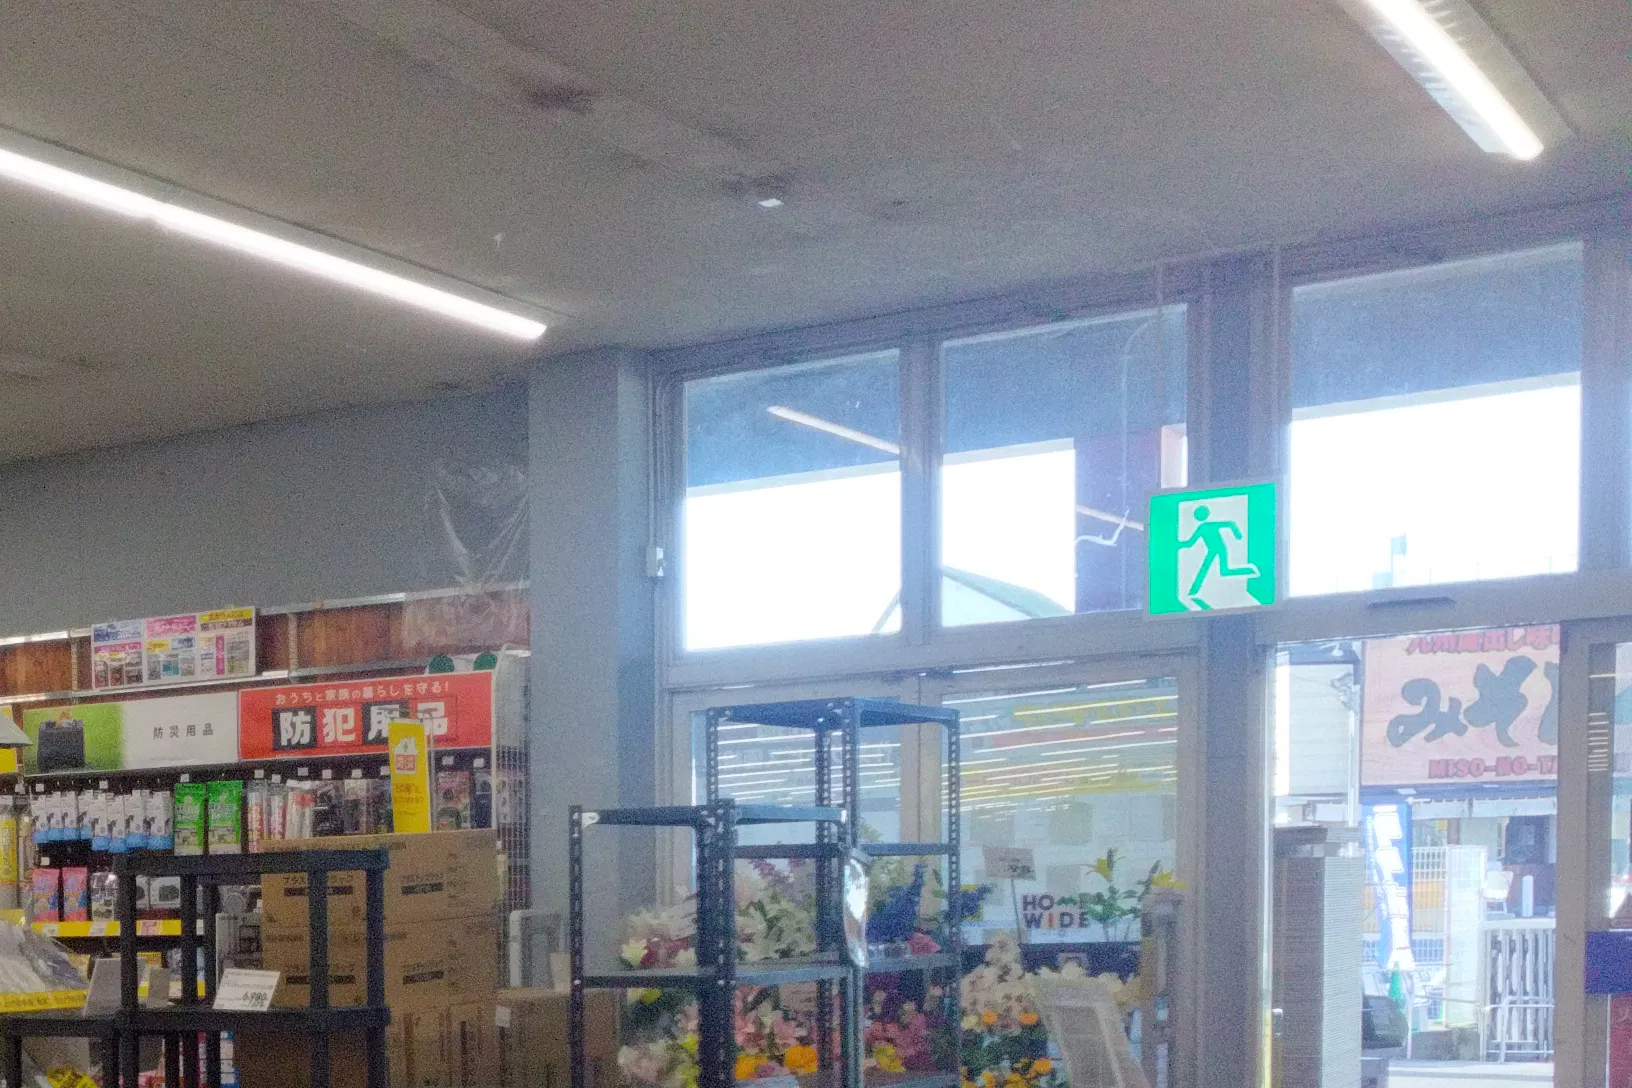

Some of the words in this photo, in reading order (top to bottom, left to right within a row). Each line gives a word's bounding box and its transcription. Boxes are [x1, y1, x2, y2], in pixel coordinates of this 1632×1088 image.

[152, 722, 215, 740] 防災用品
[279, 701, 449, 745] 防犯用品
[1022, 911, 1090, 929] WIDE
